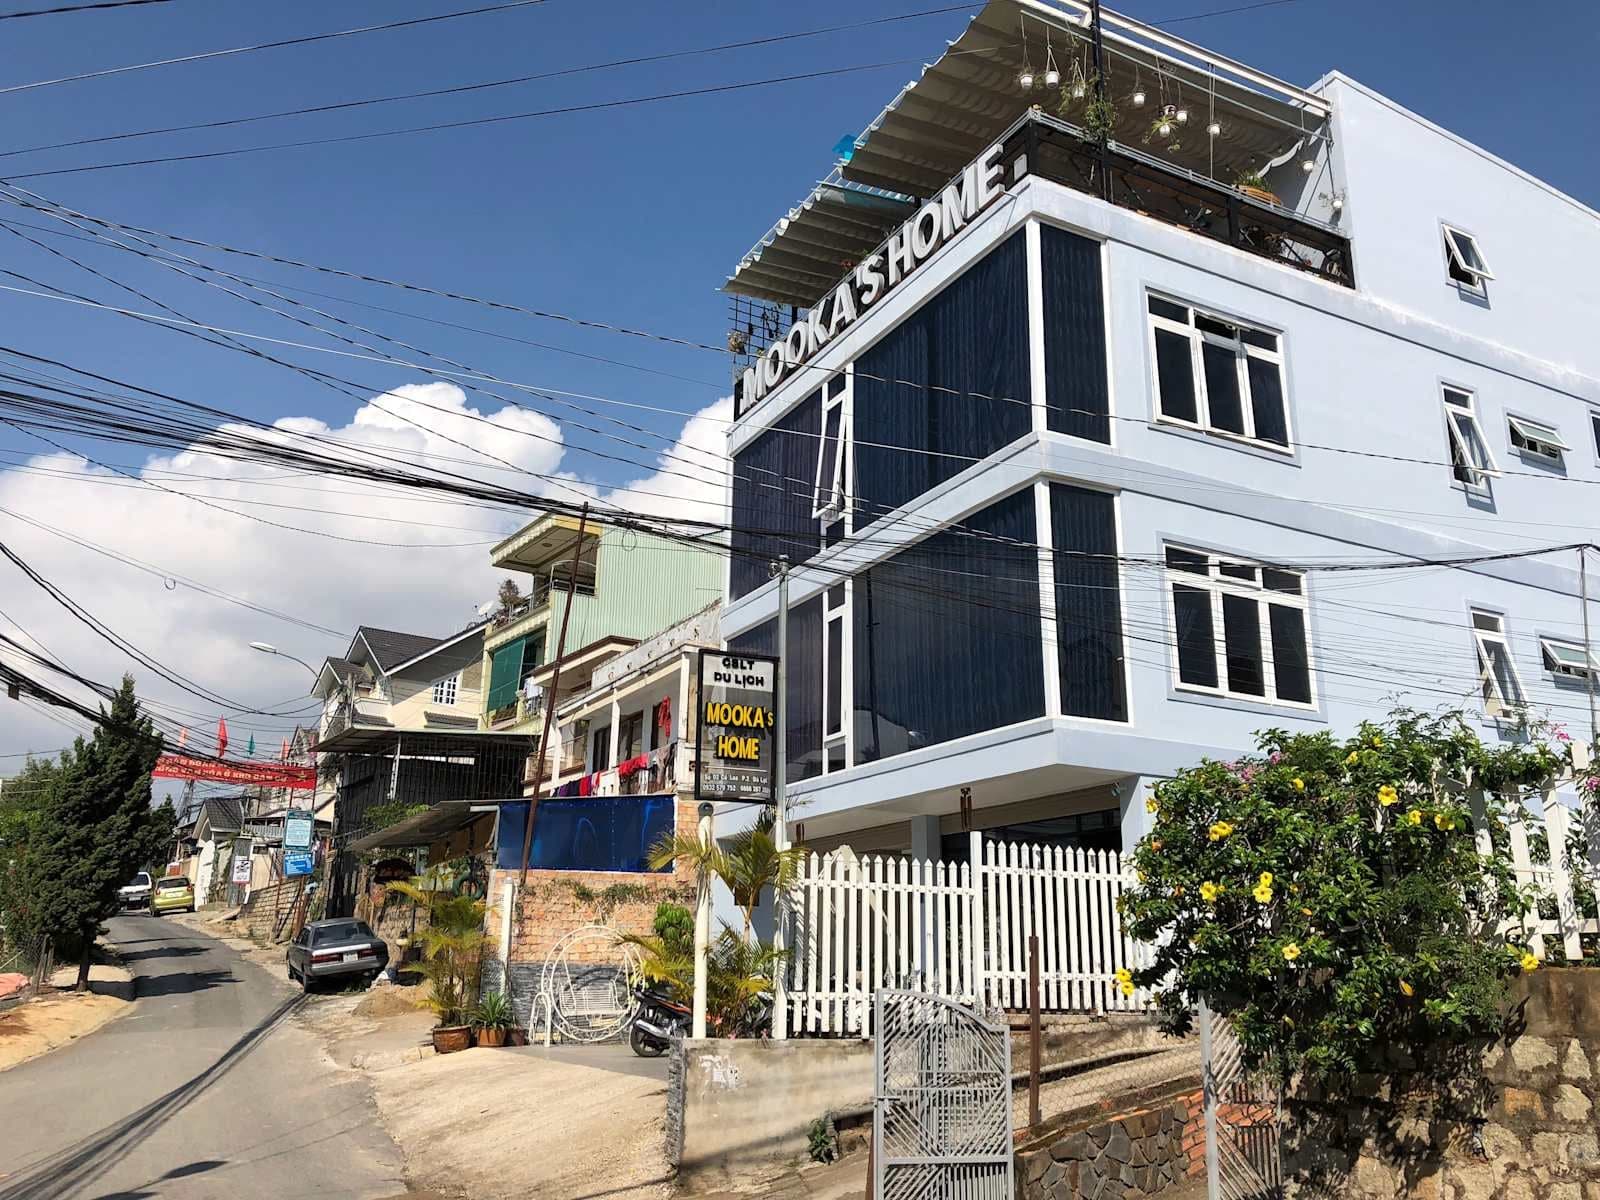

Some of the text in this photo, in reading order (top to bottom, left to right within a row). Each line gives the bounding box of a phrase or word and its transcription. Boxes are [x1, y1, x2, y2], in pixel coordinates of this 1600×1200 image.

[739, 143, 1006, 414] MOOKA'S HOME
[714, 671, 731, 683] DU
[706, 702, 773, 729] MOOKA's
[717, 735, 760, 760] HOME
